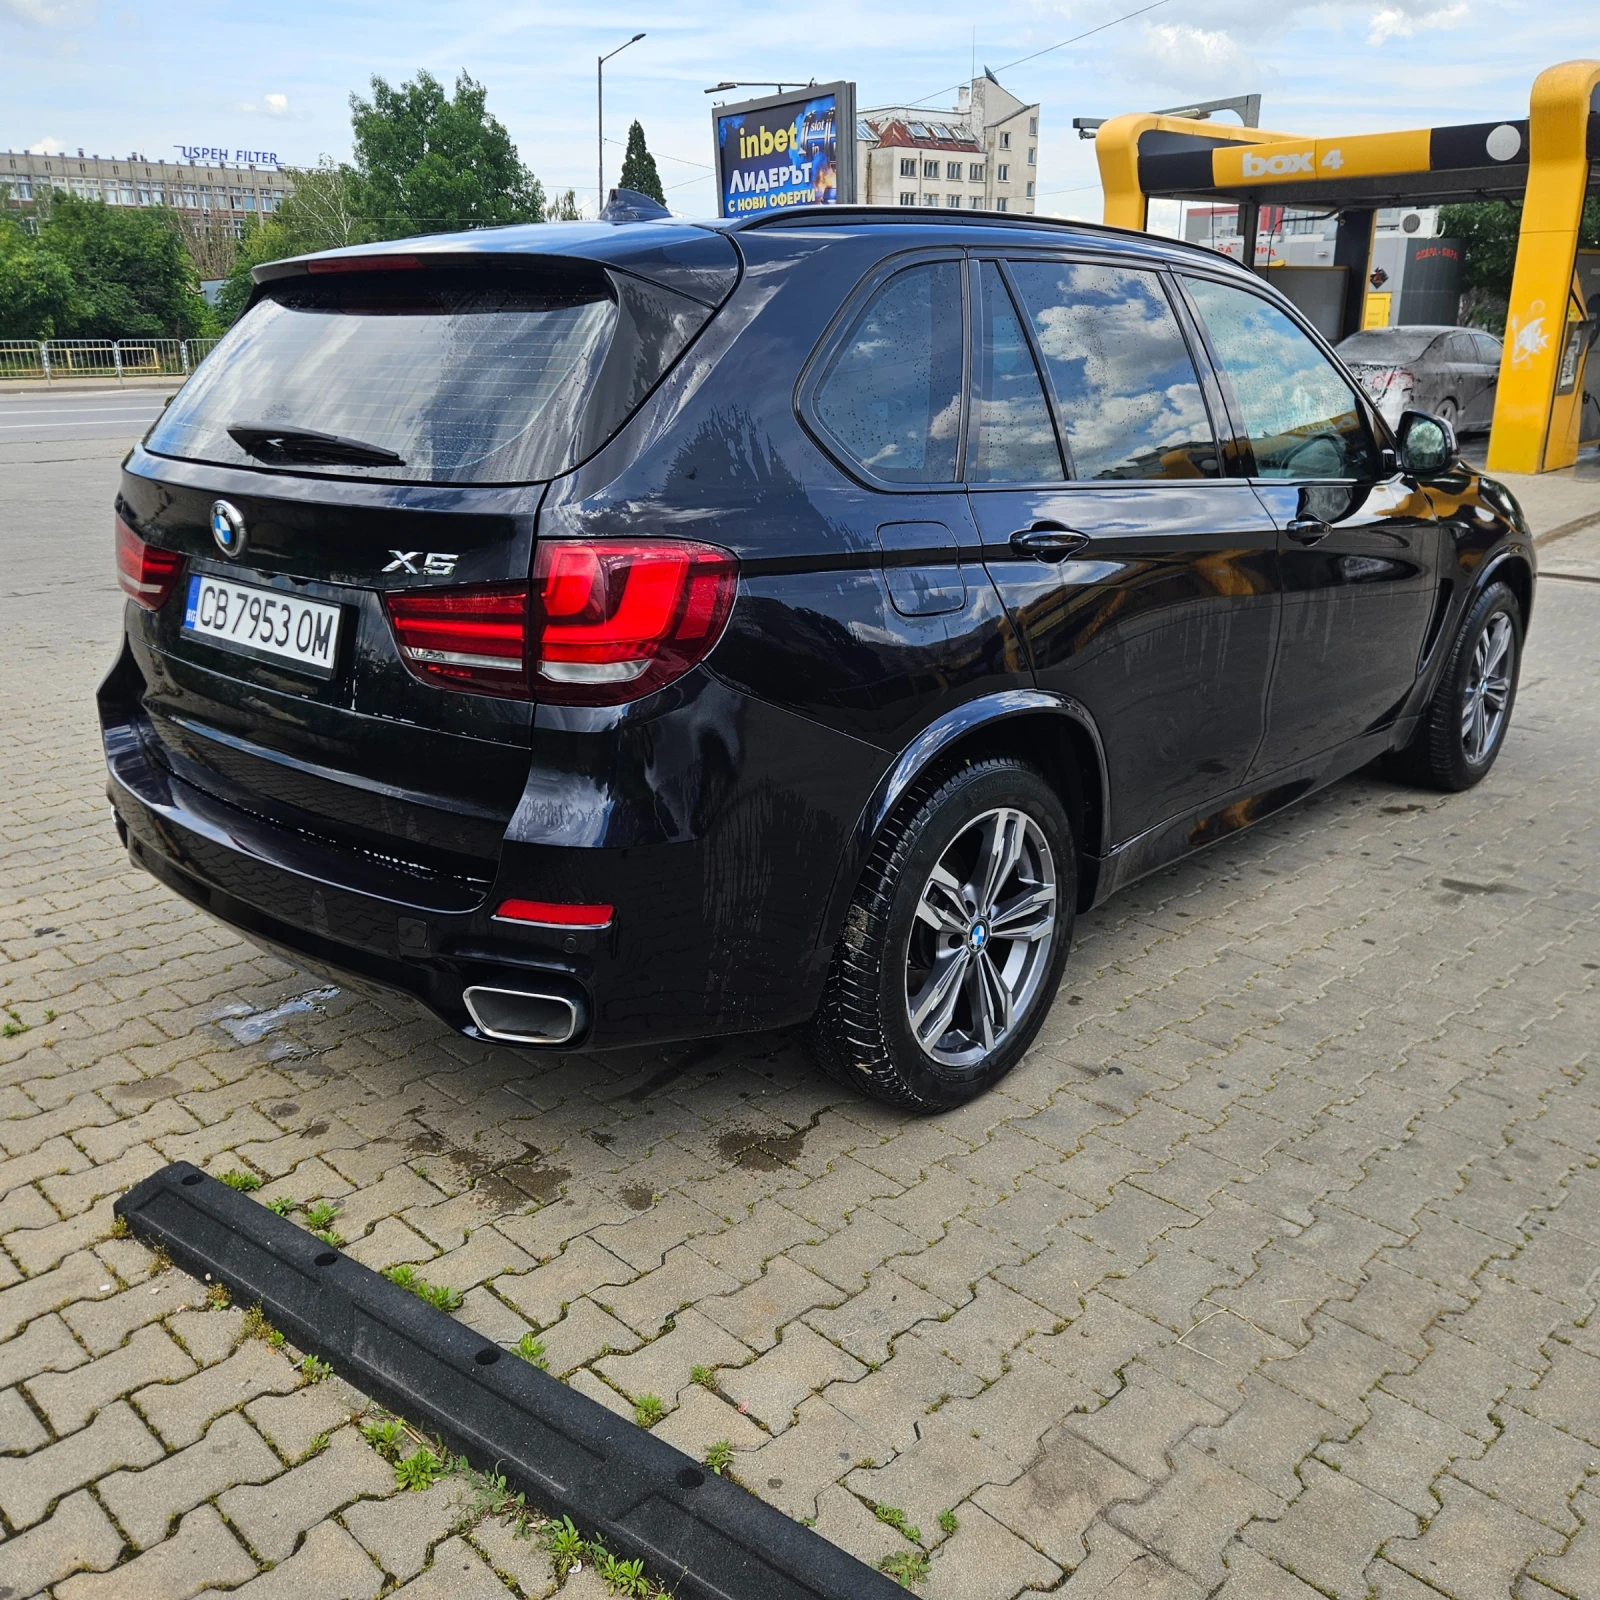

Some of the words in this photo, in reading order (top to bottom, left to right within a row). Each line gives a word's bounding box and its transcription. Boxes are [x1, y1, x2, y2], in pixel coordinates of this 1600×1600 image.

[810, 120, 825, 132] slot
[739, 122, 798, 159] inbet
[173, 145, 228, 160] USPEH
[236, 150, 285, 165] FILTER
[1243, 152, 1314, 177] box
[1321, 149, 1344, 170] 4
[730, 162, 812, 194] ЛИДЕРЪТ
[738, 194, 767, 211] НОВИ
[769, 189, 816, 207] ОФЕРТИ
[381, 549, 459, 577] X5
[186, 608, 197, 622] BG
